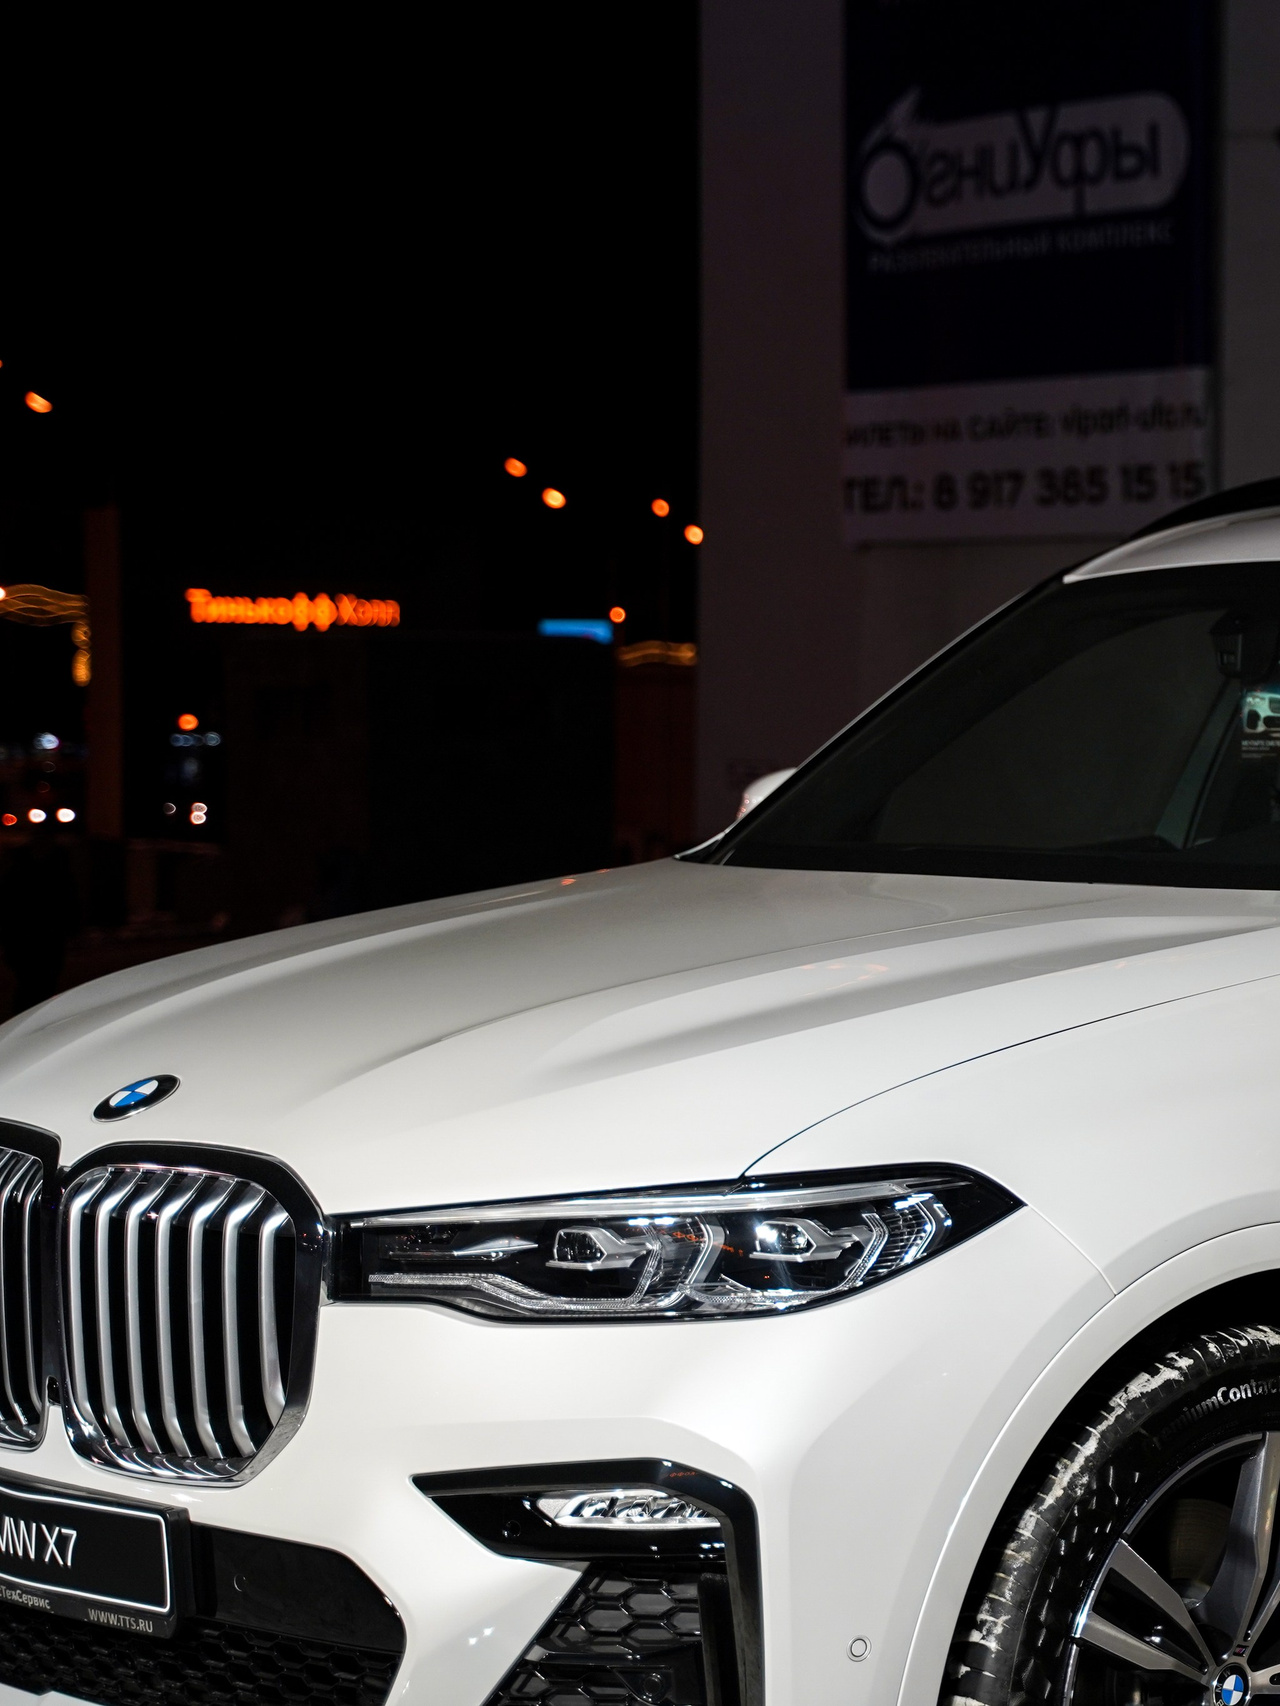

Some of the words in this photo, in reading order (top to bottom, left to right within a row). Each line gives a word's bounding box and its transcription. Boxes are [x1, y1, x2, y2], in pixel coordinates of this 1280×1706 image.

[933, 471, 957, 511] 8
[967, 469, 1026, 510] 917
[1120, 461, 1157, 503] 15
[1168, 458, 1206, 499] 15
[40, 1522, 77, 1568] X7
[88, 1608, 153, 1633] WWW.TTS.RU
